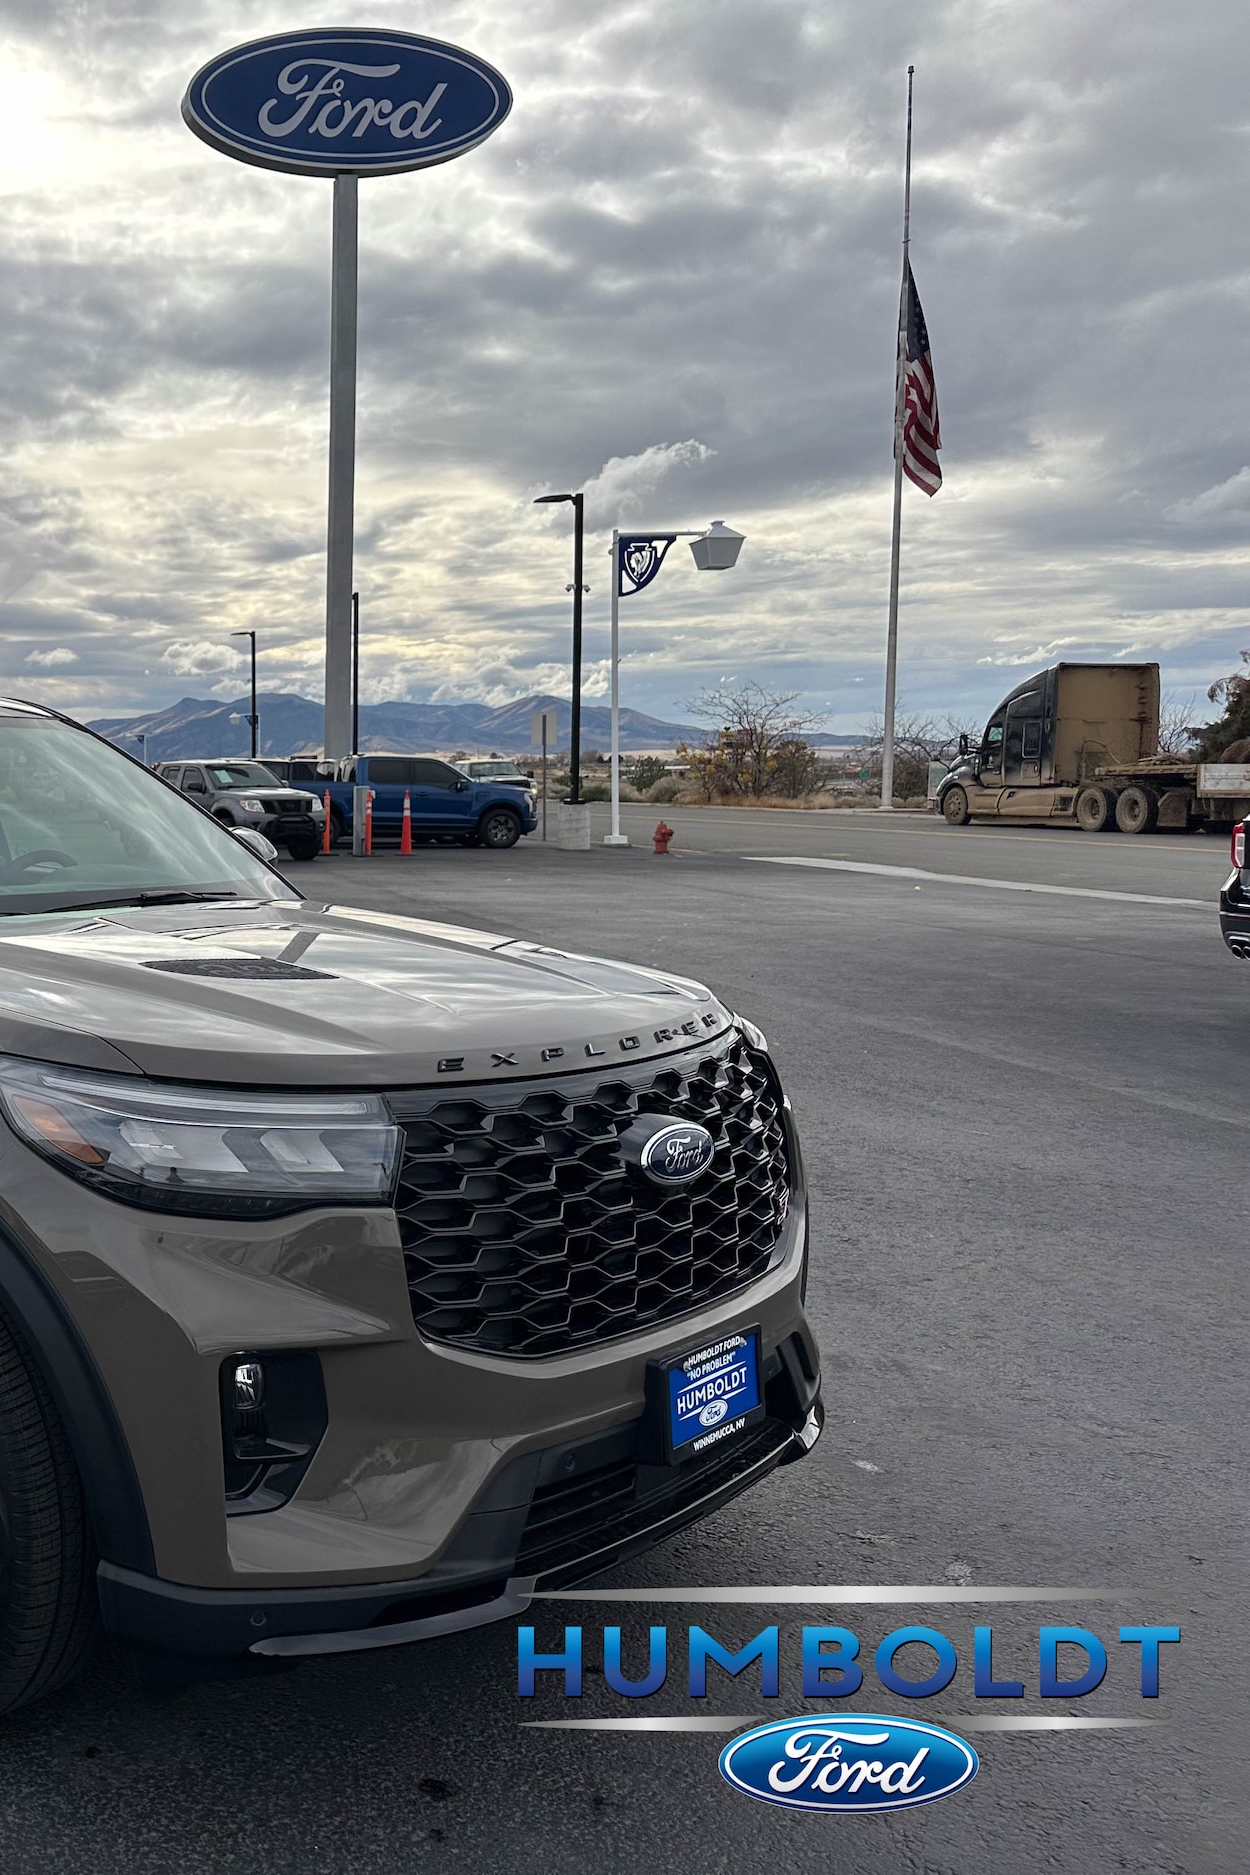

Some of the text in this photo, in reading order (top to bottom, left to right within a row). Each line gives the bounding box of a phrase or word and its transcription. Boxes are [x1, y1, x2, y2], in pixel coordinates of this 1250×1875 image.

[258, 58, 448, 139] Ford
[437, 1012, 719, 1073] EXPLORER
[665, 1136, 705, 1174] Ford
[688, 1336, 741, 1366] HUMBOLDT FORD
[677, 1366, 747, 1415] HUMBOLDT
[693, 1424, 736, 1452] WINNEMUCCA,
